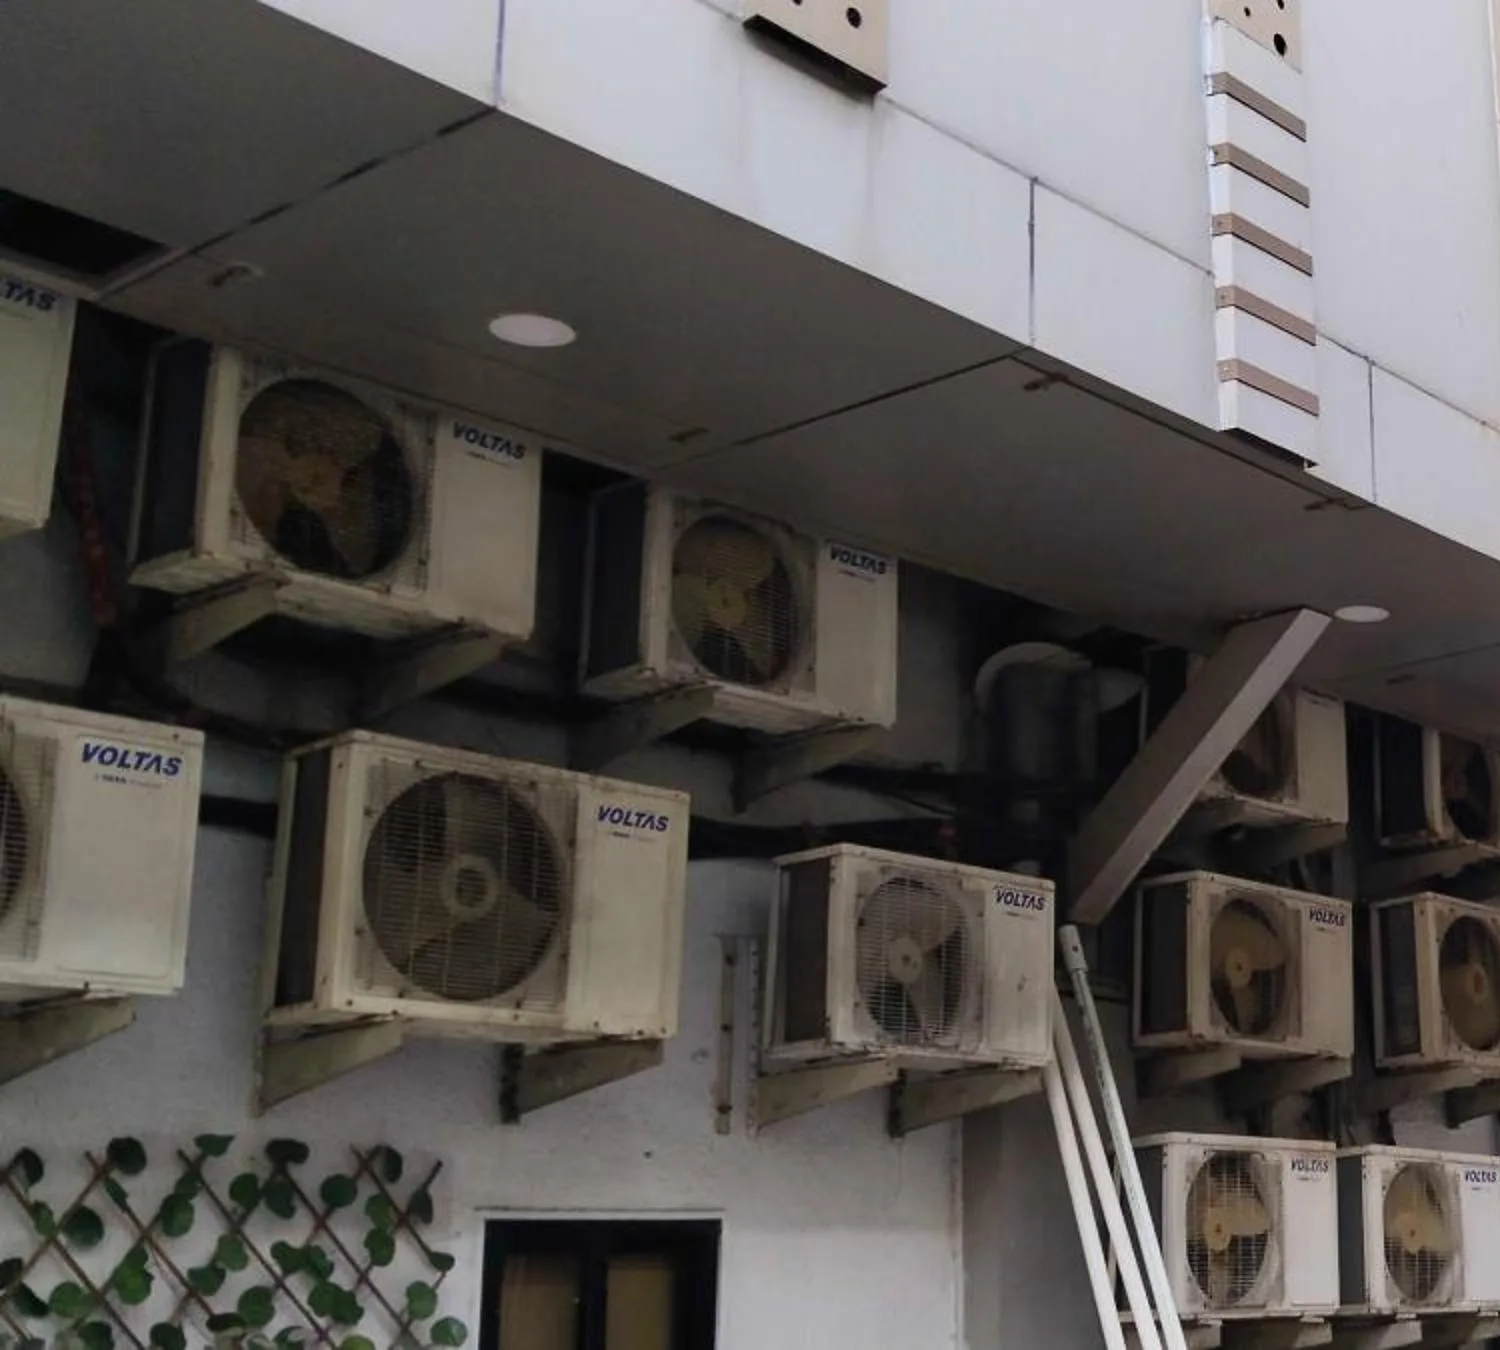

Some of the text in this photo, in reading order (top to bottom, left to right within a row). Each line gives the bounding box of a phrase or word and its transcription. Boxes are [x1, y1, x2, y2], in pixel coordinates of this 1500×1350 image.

[0, 280, 56, 311] TAS
[453, 421, 527, 460] VOLTAS
[830, 546, 886, 575] VOLTAS
[82, 743, 182, 776] VOLTAS
[598, 805, 669, 832] VOLTAS
[996, 889, 1045, 911] VOLTAS
[1309, 908, 1345, 927] VOLTAS
[1291, 1158, 1329, 1173] VOLTAS
[1465, 1169, 1497, 1183] VOLTAS
